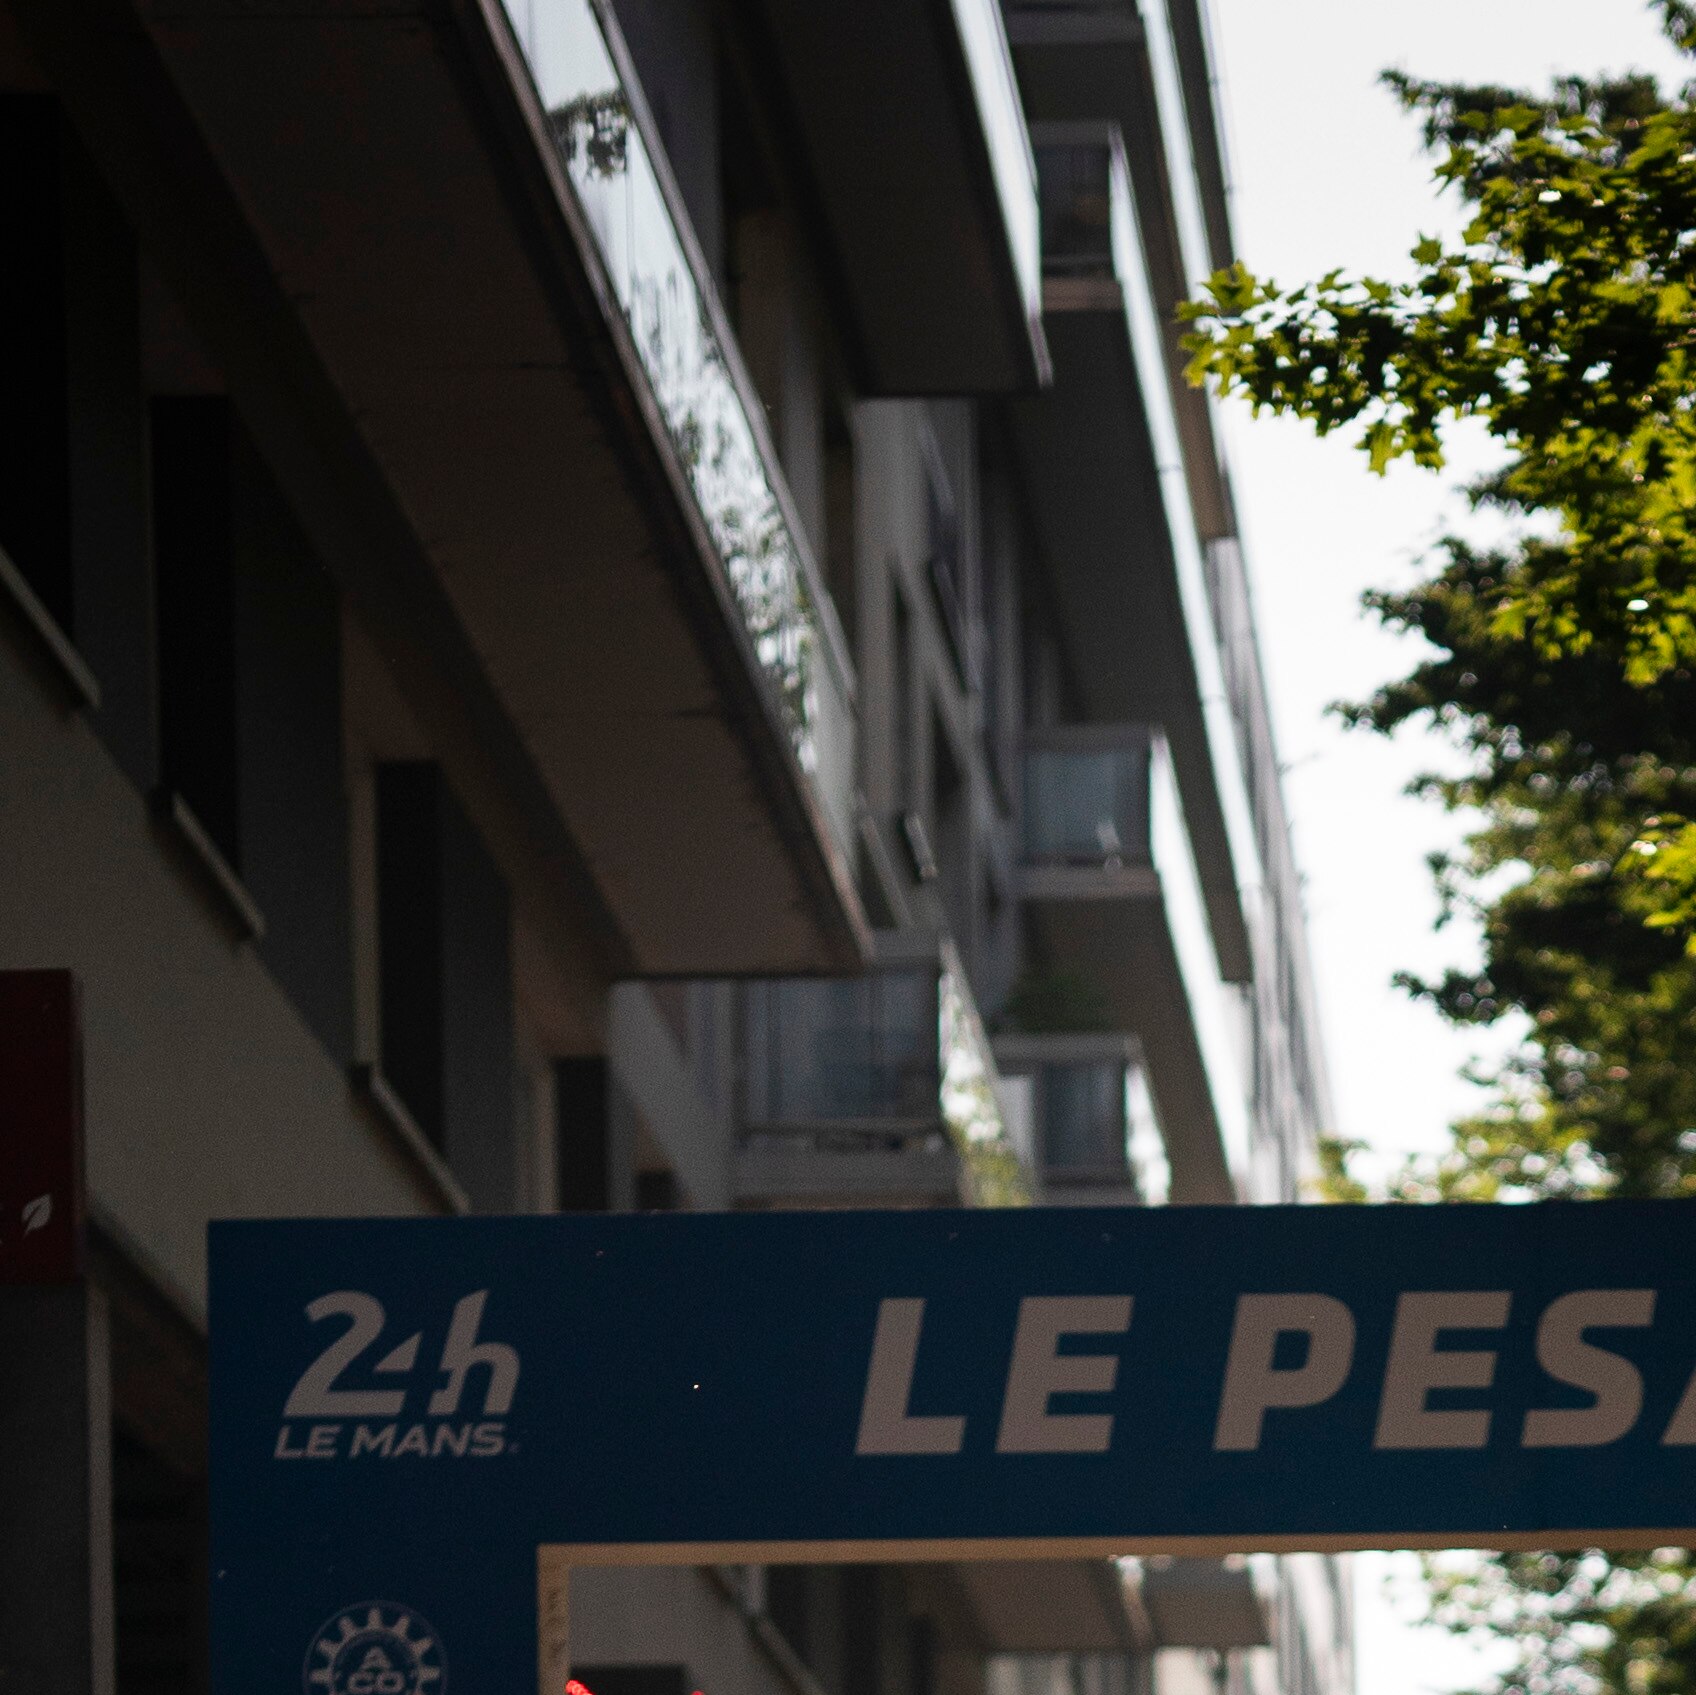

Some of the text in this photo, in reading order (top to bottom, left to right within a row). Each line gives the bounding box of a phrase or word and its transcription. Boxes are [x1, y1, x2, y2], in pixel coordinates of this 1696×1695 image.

[282, 1287, 522, 1419] 24h
[854, 1293, 1136, 1455] LE
[272, 1422, 508, 1461] LE MANS
